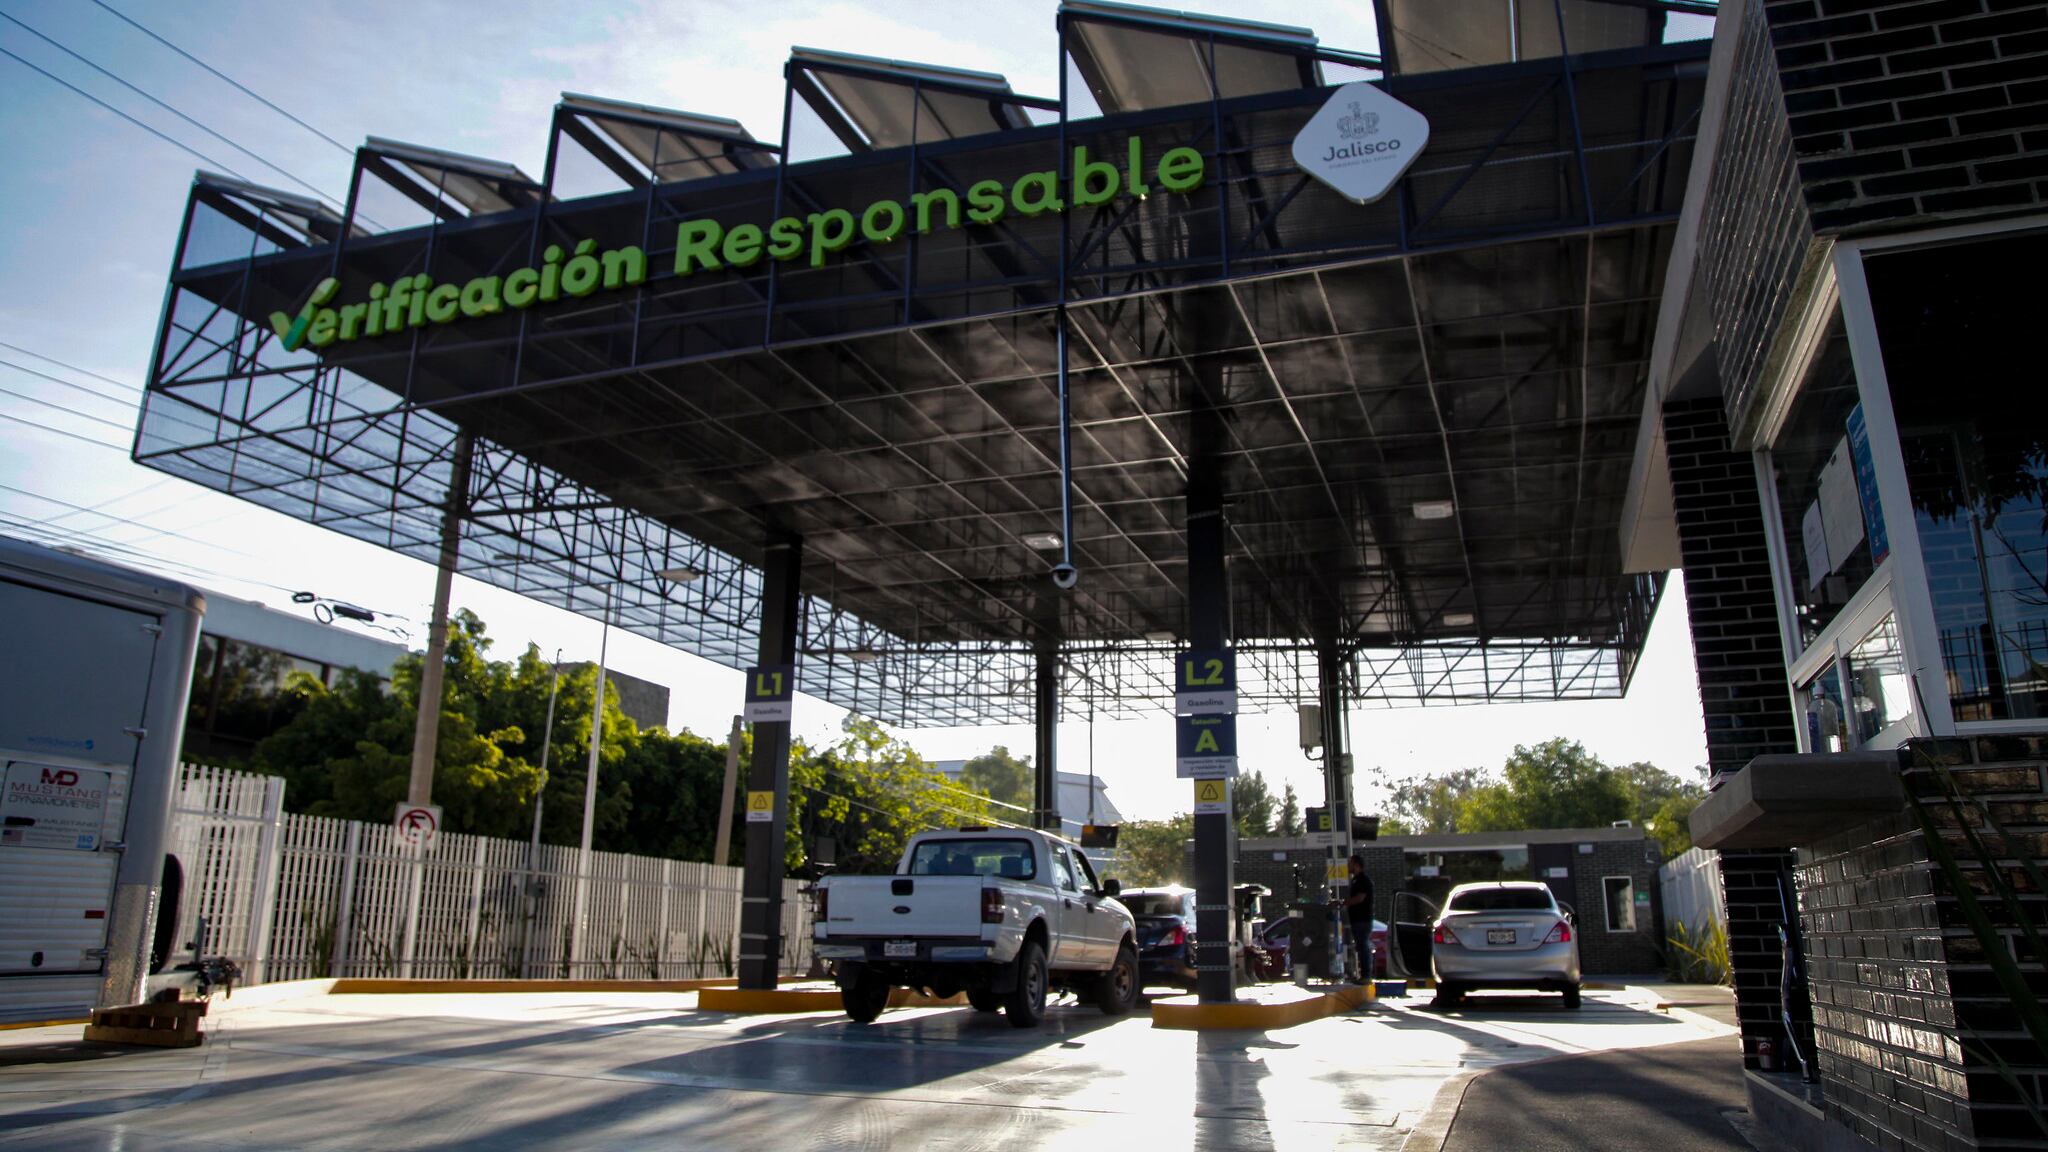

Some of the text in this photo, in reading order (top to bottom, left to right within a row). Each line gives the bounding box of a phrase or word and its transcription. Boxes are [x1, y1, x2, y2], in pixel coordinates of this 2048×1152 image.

[1323, 139, 1401, 162] Jalisco
[269, 136, 1204, 352] Verificación Responsable
[1185, 659, 1224, 686] L2
[756, 672, 782, 696] L1
[1187, 698, 1224, 707] Gasolina
[1195, 728, 1219, 752] A
[40, 768, 79, 786] MD
[11, 782, 101, 800] MUSTANG
[8, 794, 101, 809] DYNAMOMETER
[1319, 815, 1332, 830] B
